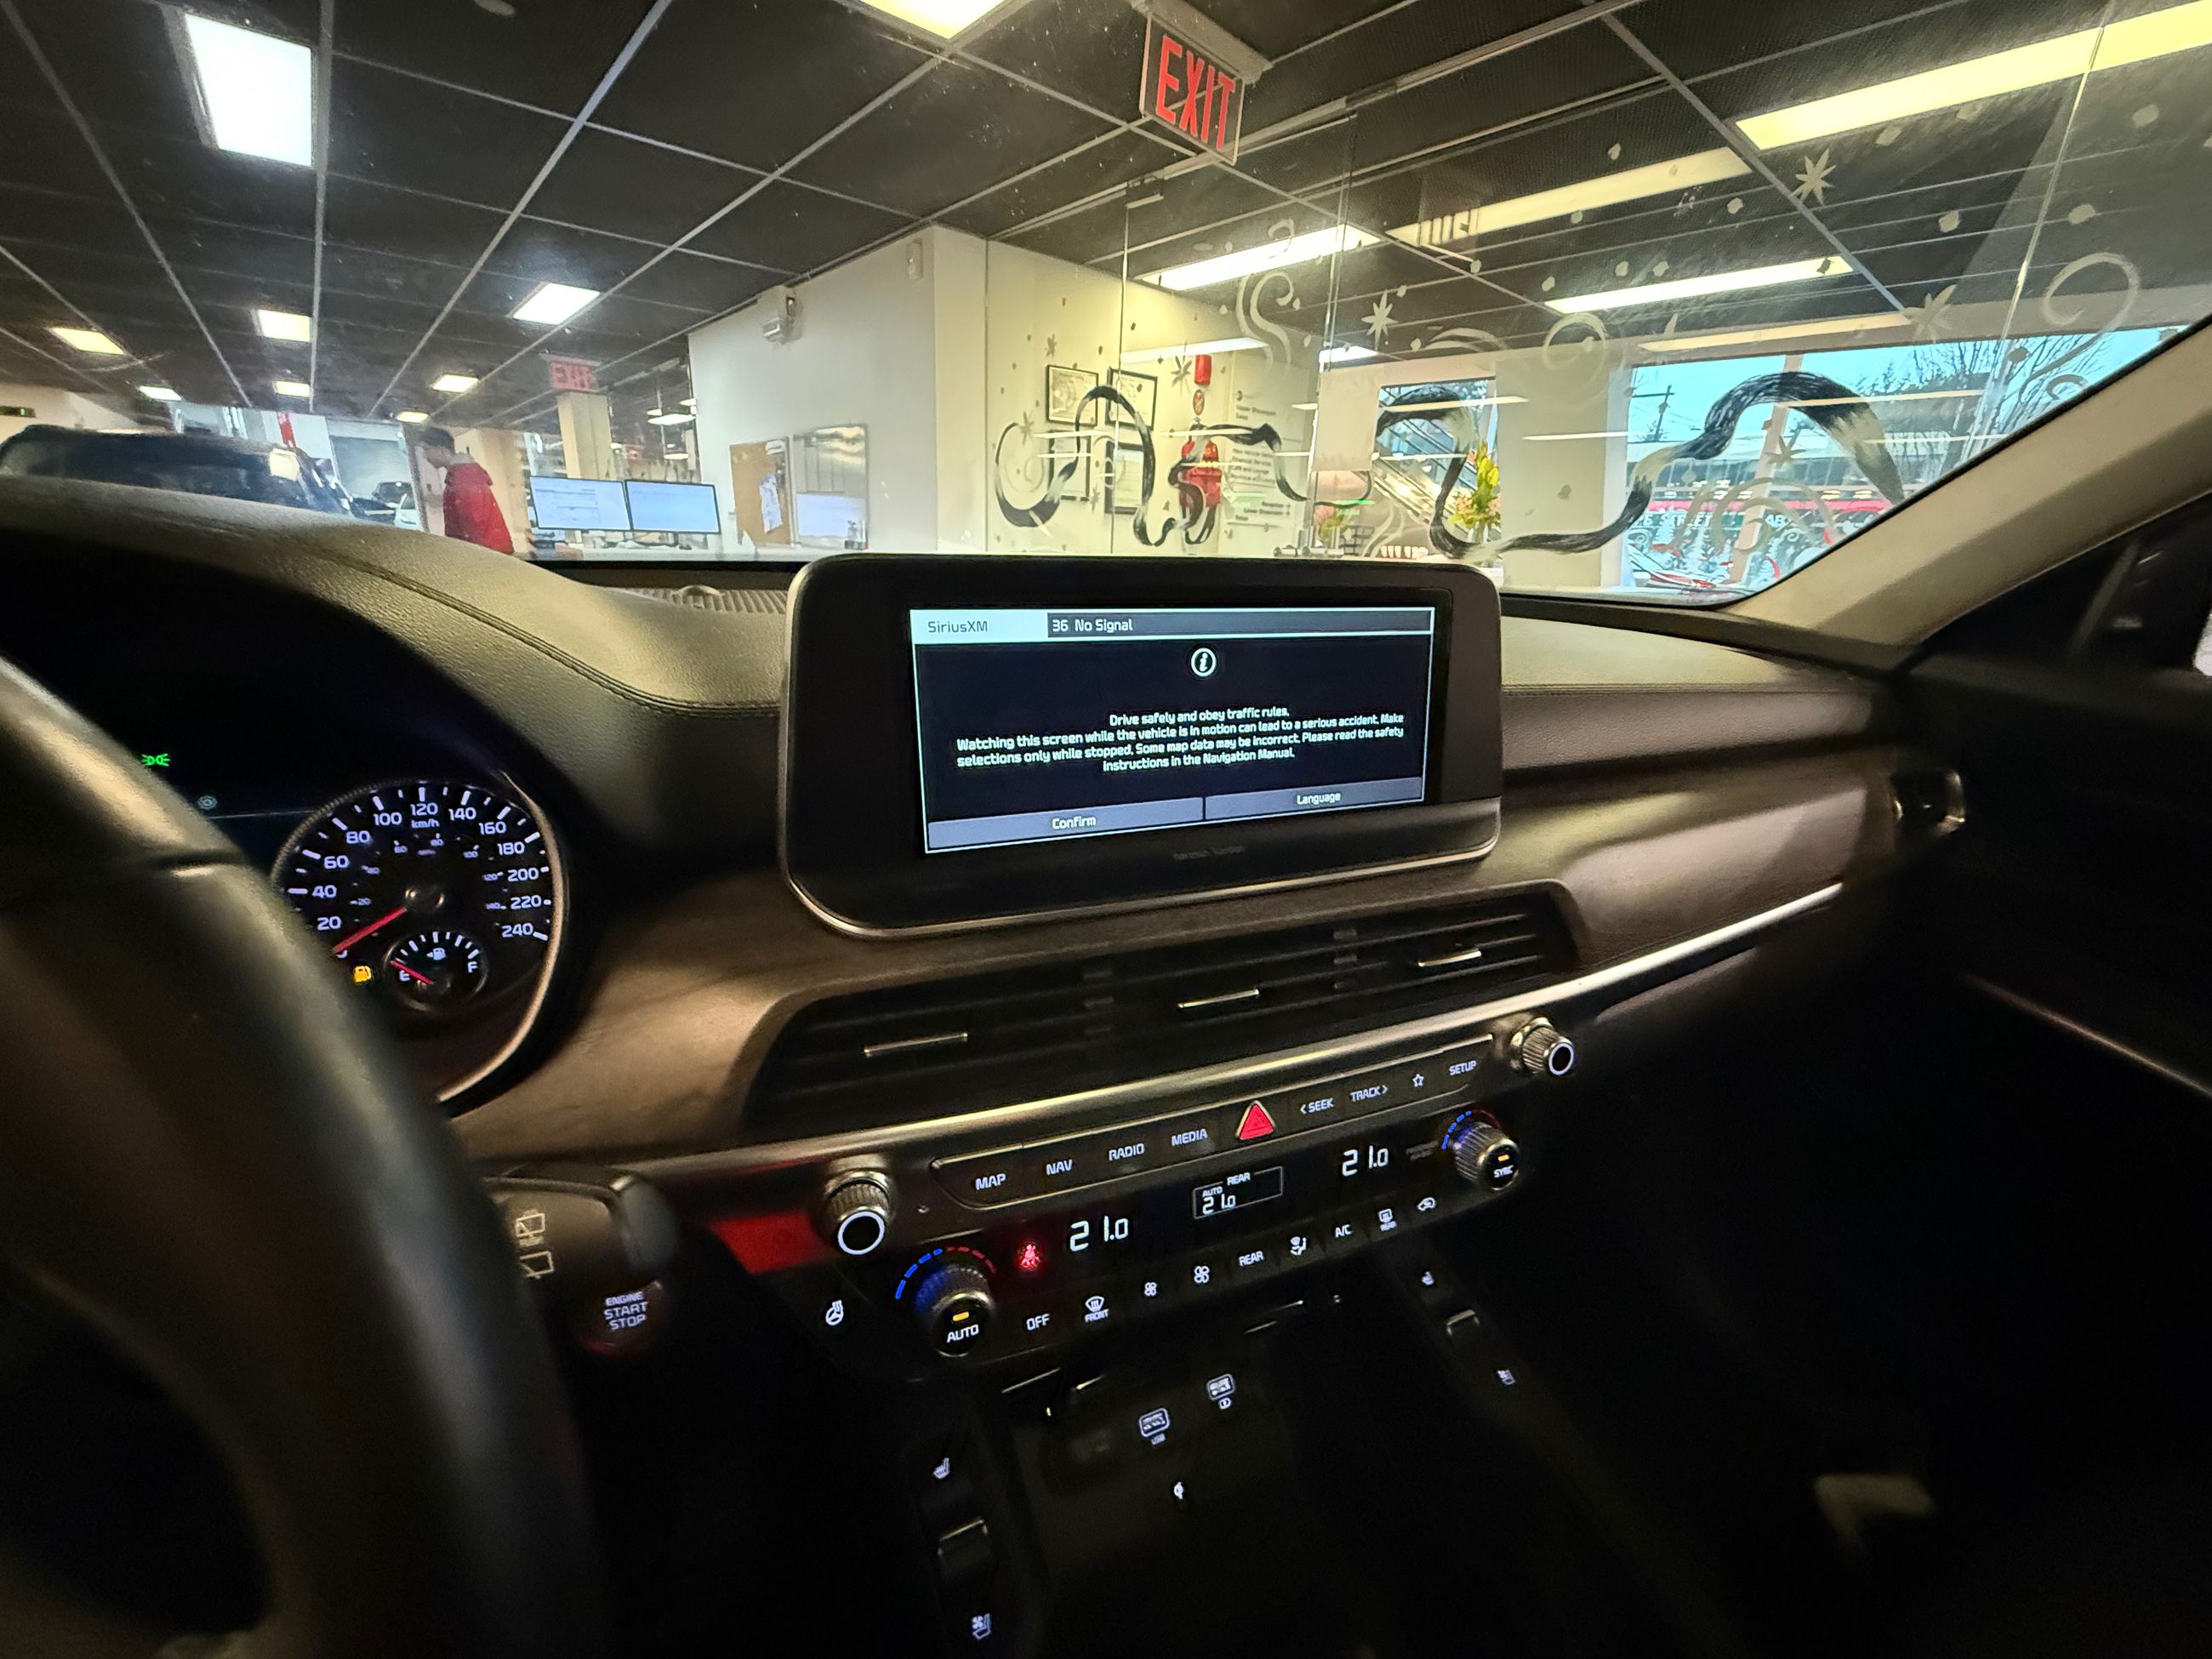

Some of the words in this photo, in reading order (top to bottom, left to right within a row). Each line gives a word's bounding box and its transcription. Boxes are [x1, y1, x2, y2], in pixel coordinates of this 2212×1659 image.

[1155, 34, 1236, 151] EXIT
[928, 620, 988, 633] SiriusXM
[1052, 619, 1069, 632] 36
[1075, 619, 1092, 632] No
[1095, 618, 1133, 633] Signal
[1109, 714, 1139, 727] Drive
[1141, 712, 1175, 725] safely
[1177, 710, 1197, 721] and
[1199, 709, 1225, 721] obey
[1227, 707, 1261, 720] traffic
[1262, 706, 1290, 718] rules.
[956, 737, 1014, 751] Watching
[1017, 734, 1040, 748] this
[1042, 734, 1083, 746] screen
[1086, 729, 1115, 743] while
[1116, 728, 1136, 741] the
[1137, 726, 1177, 740] vehicle
[1178, 725, 1189, 737] is
[1190, 725, 1200, 737] in
[1201, 723, 1237, 736] motion
[1238, 723, 1257, 733] can
[1258, 720, 1280, 733] lead
[1281, 720, 1292, 731] to
[1294, 721, 1301, 730] a
[1303, 718, 1337, 729] serious
[1338, 715, 1379, 727] accident.
[1381, 713, 1404, 724] Make
[956, 752, 1022, 767] selections
[1023, 750, 1051, 764] only
[1052, 747, 1082, 761] while
[1084, 744, 1134, 759] stopped.
[1135, 741, 1165, 755] Some
[1166, 741, 1189, 755] map
[1190, 739, 1214, 751] data
[1216, 738, 1236, 750] may
[1238, 736, 1251, 747] be
[1252, 733, 1300, 746] incorrect.
[1302, 730, 1333, 743] Please
[1334, 728, 1356, 740] read
[1358, 727, 1373, 738] the
[1375, 726, 1404, 738] safety
[1103, 755, 1169, 772] instructions
[1171, 755, 1182, 767] in
[1183, 753, 1200, 766] the
[1202, 750, 1257, 765] Navigation
[1257, 748, 1295, 761] Manual.
[1297, 792, 1342, 807] Language
[410, 803, 438, 817] 120
[448, 807, 476, 821] 140
[373, 812, 402, 826] 100
[411, 818, 439, 830] km/h
[1051, 815, 1097, 830] Confirm
[479, 821, 507, 835] 160
[345, 830, 371, 845] 80
[497, 841, 526, 855] 180
[323, 856, 350, 869] 60
[507, 869, 539, 881] 200
[312, 885, 337, 898] 40
[510, 896, 542, 909] 220
[316, 916, 342, 931] 20
[501, 922, 534, 938] 240
[468, 961, 478, 972] F
[1448, 1059, 1477, 1076] SETUP
[1350, 1085, 1380, 1103] TRACK
[1308, 1097, 1334, 1114] SEEK
[1171, 1128, 1208, 1147] MEDIA
[1109, 1143, 1145, 1161] RADIO
[1046, 1159, 1073, 1176] NAV
[1342, 1146, 1389, 1177] 21.0
[975, 1173, 1006, 1190] MAP
[1227, 1172, 1251, 1187] REAR
[1201, 1186, 1223, 1198] AUTO
[1202, 1193, 1236, 1215] 21.0
[1069, 1215, 1130, 1252] 21.0
[1335, 1223, 1352, 1239] A/C
[1239, 1250, 1264, 1267] REAR
[605, 1291, 644, 1307] ENGINE
[603, 1301, 648, 1320] START
[609, 1314, 647, 1331] STOP
[1026, 1313, 1050, 1331] OFF
[946, 1323, 979, 1343] AUTO
